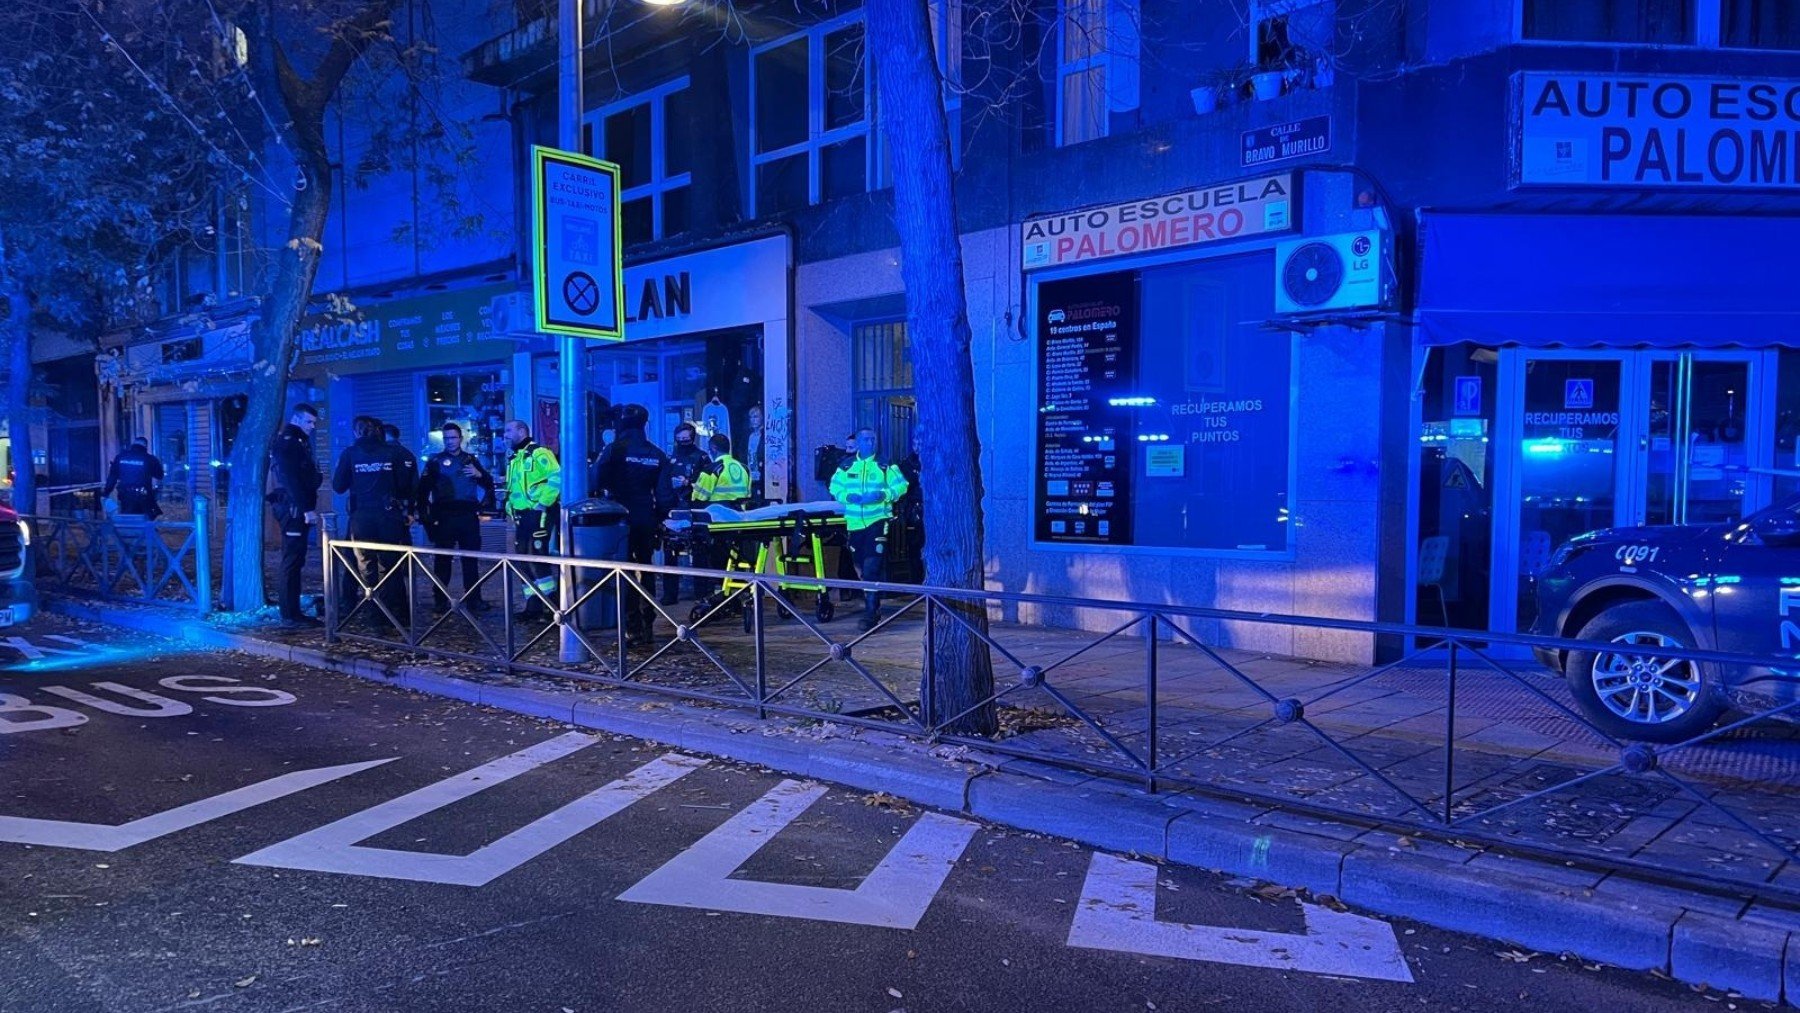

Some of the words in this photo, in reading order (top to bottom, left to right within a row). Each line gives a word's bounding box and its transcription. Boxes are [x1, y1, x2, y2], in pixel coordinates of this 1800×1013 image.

[1531, 80, 1692, 119] AUTO
[1270, 123, 1301, 137] CALLE
[1245, 145, 1276, 164] BRAVO
[1282, 135, 1325, 156] MURILLO
[1601, 126, 1800, 184] PALOM
[562, 171, 597, 187] CARRIL
[552, 181, 605, 200] EXCLUSIVO
[1026, 211, 1109, 240] AUTO
[1118, 178, 1287, 224] ESCUELA
[1057, 208, 1244, 263] PALOMERO
[1353, 259, 1369, 271] LG
[1172, 400, 1262, 416] RECUPERAMOS
[1204, 416, 1227, 428] TUS
[1525, 412, 1618, 425] RECUPERAMOS
[1192, 430, 1240, 443] PUNTOS
[1559, 427, 1584, 439] TUS
